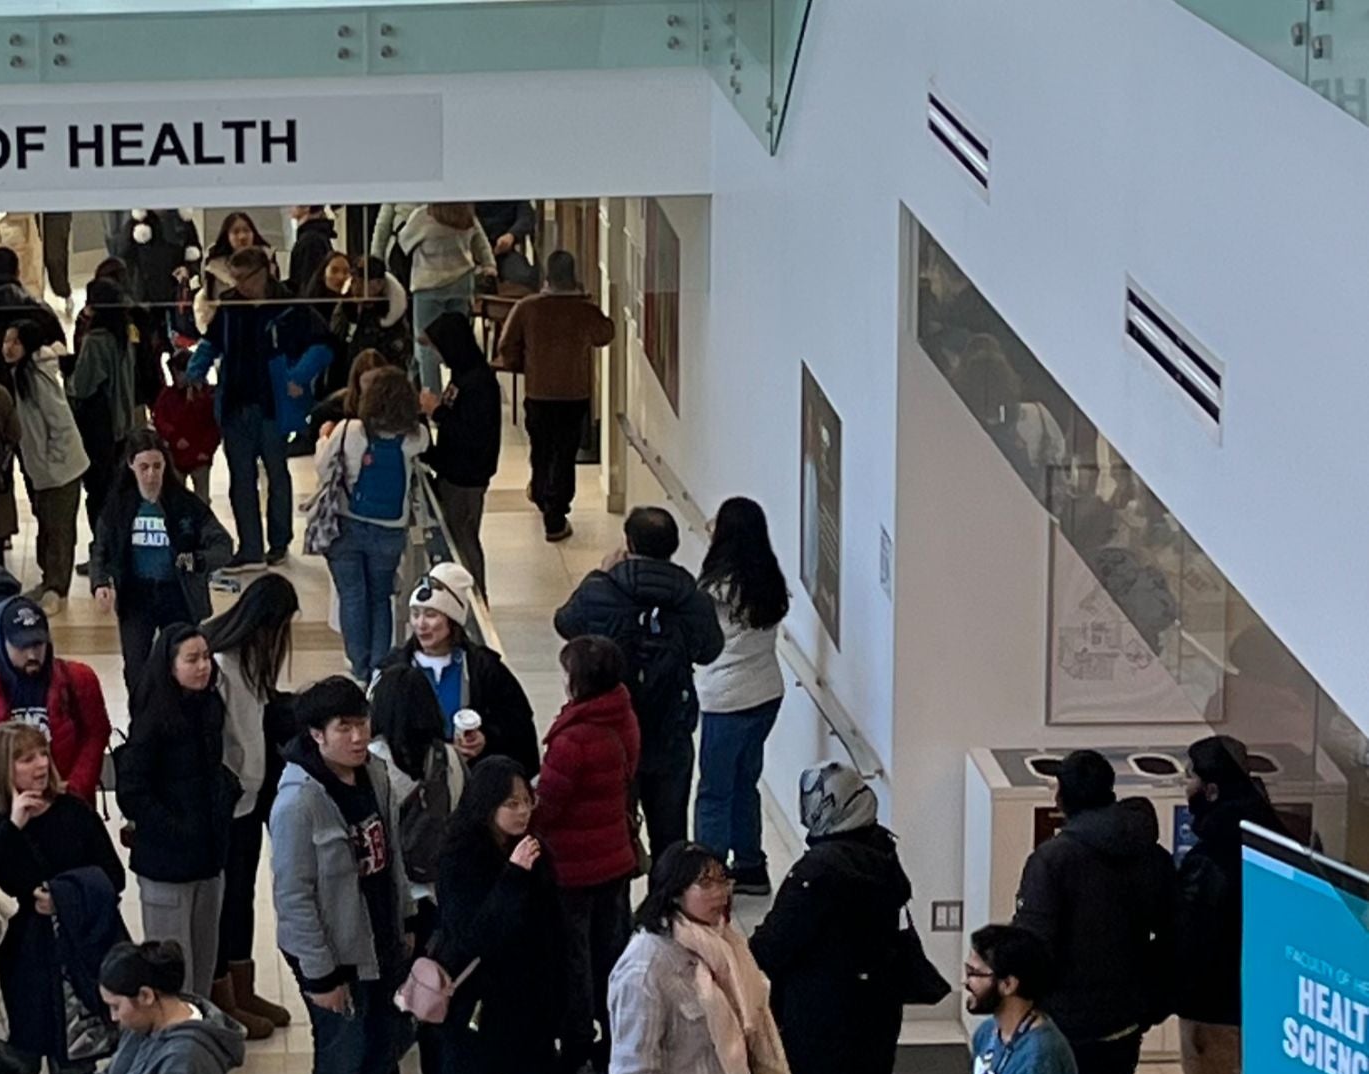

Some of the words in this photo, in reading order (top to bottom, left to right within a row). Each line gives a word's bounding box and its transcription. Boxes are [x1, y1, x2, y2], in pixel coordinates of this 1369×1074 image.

[68, 119, 299, 169] HEALTH
[1284, 945, 1333, 979] FACULTY
[1298, 975, 1369, 1045] HEALT
